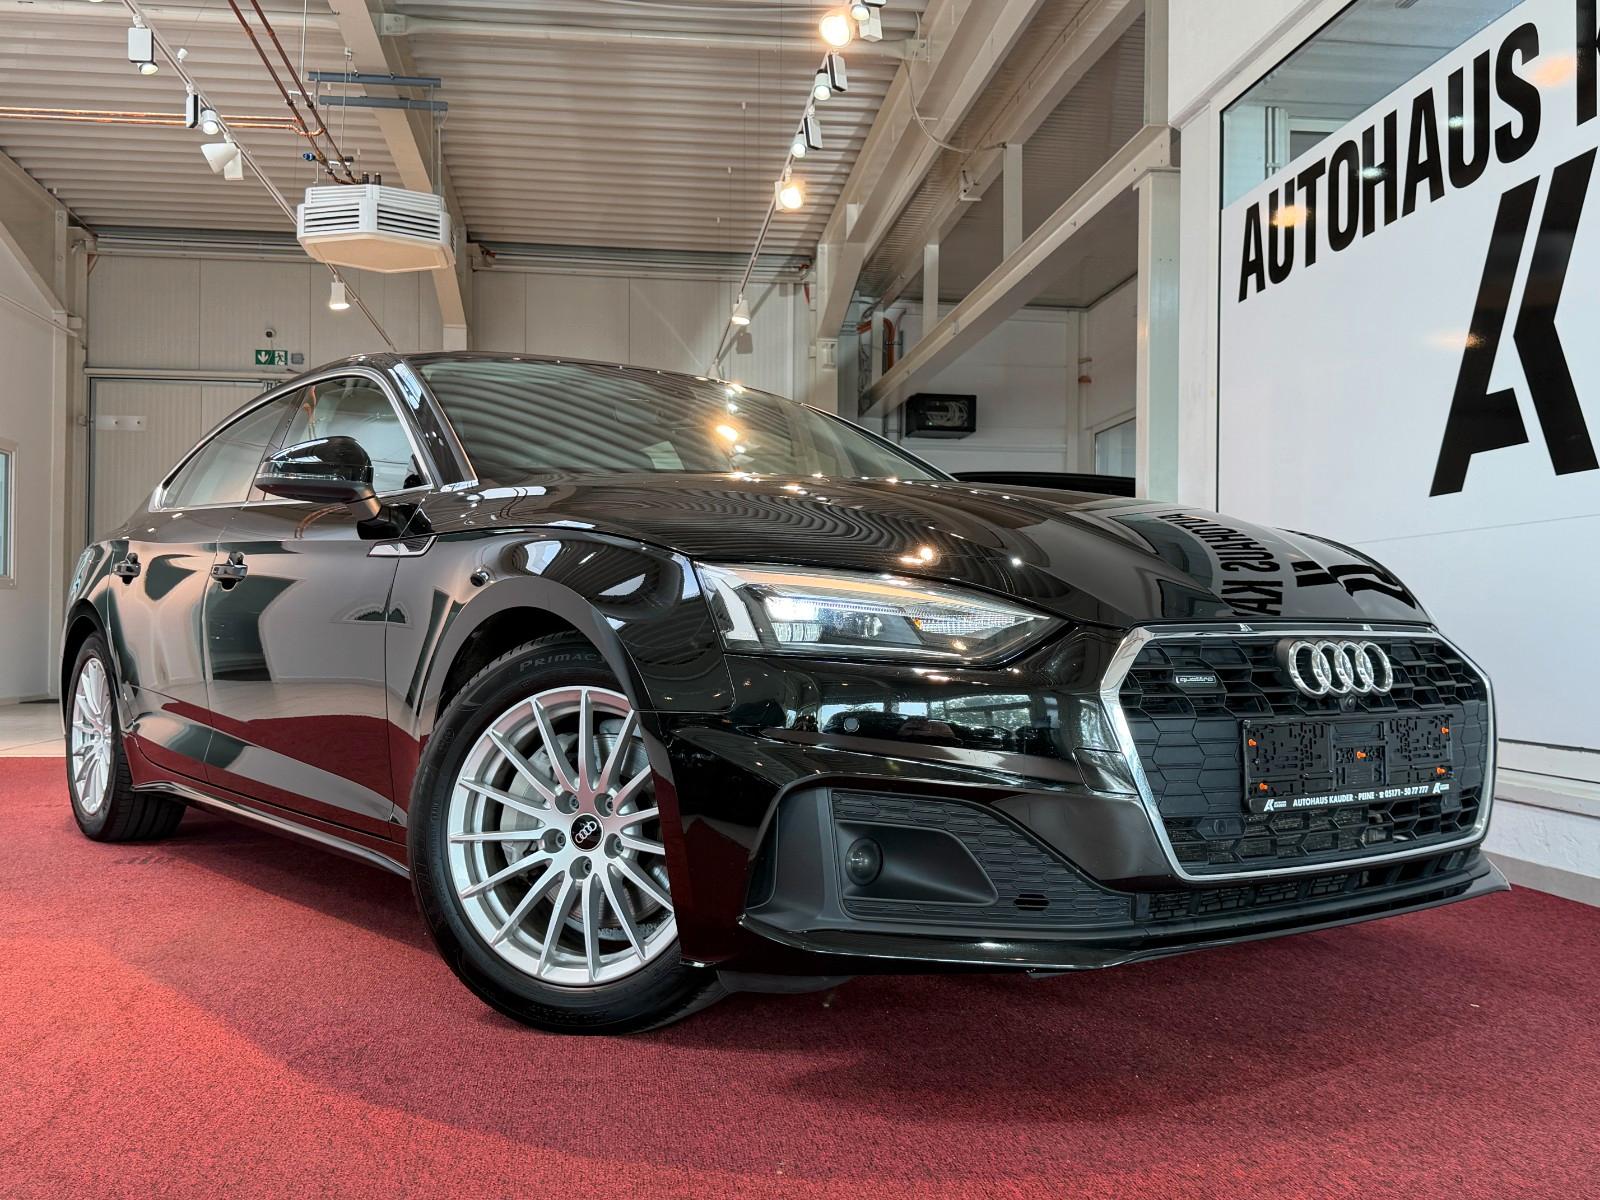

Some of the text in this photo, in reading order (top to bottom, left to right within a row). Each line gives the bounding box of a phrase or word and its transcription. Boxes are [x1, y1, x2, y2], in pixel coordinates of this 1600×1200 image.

[1238, 22, 1541, 303] AUTOHAUS
[1292, 796, 1328, 807] AUTOHAUS
[1328, 793, 1354, 804] KAUDER
[1358, 792, 1375, 800] PEINE
